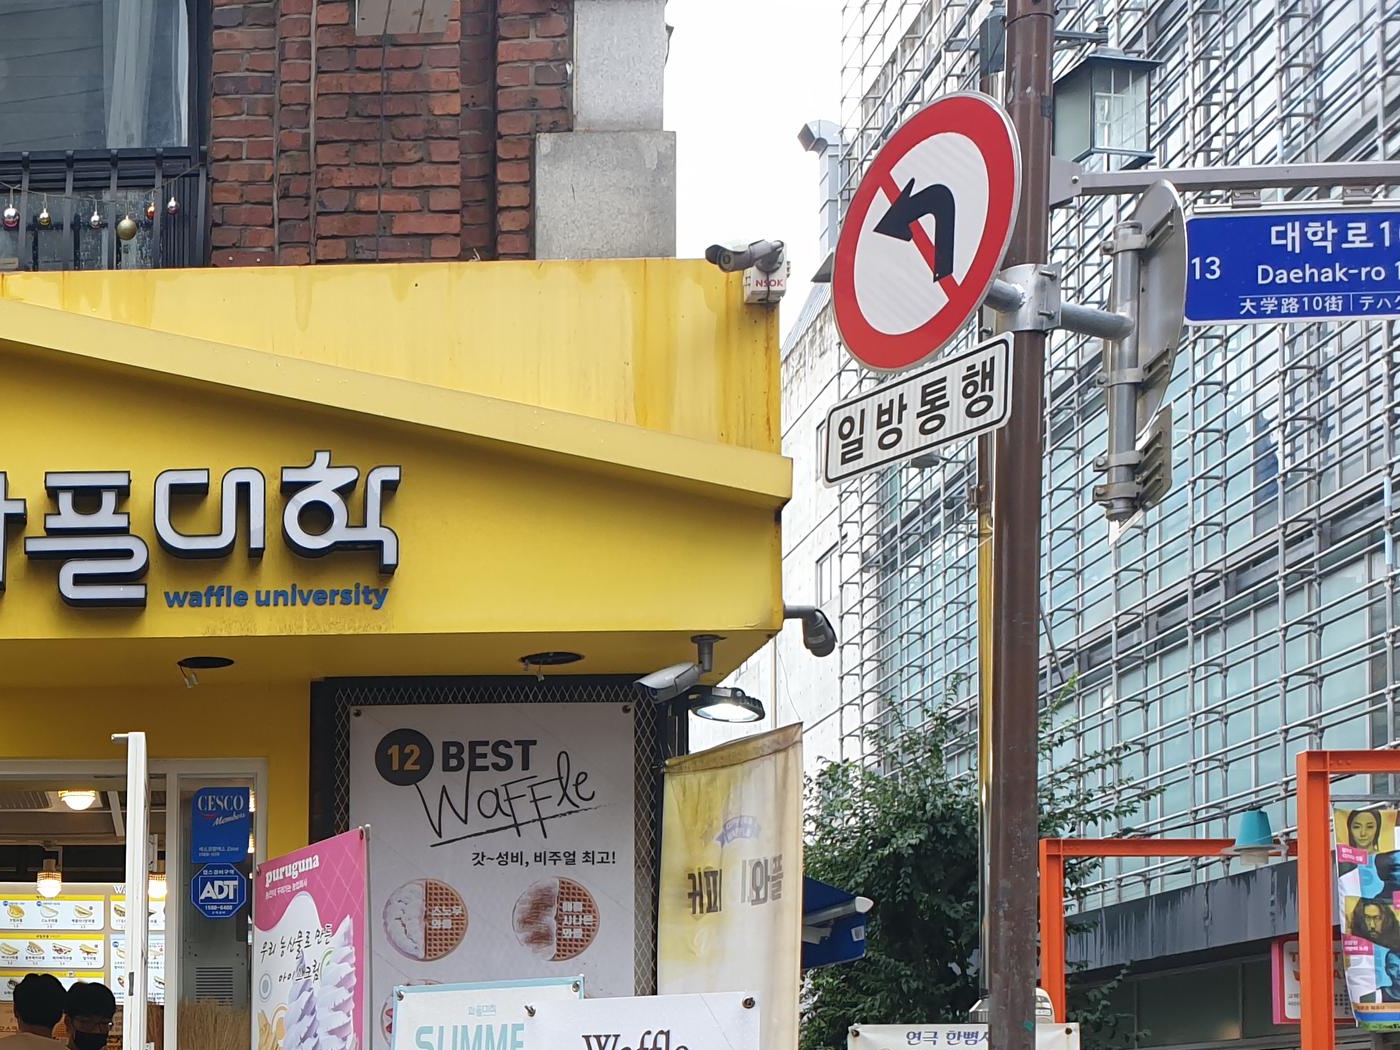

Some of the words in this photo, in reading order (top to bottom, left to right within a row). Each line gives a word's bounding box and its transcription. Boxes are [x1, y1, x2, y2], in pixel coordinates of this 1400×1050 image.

[1271, 220, 1400, 254] 대학로1
[1191, 257, 1221, 280] 13
[1257, 263, 1385, 285] Daehak-ro
[754, 277, 784, 289] NSOK
[1239, 296, 1343, 315] 大学路10街
[836, 354, 997, 460] 일방통행
[164, 585, 249, 608] waffle
[255, 583, 389, 610] university
[386, 746, 421, 771] 12
[441, 740, 537, 772] BEST
[198, 795, 244, 811] CESCO
[471, 849, 529, 867] 갓~성비,
[533, 850, 577, 867] 비주얼
[580, 850, 616, 866] 최고!
[265, 854, 320, 888] puruguna
[751, 854, 783, 905] 와플
[200, 880, 238, 900] ADT
[260, 941, 276, 963] 우리
[314, 926, 333, 944] 만든
[906, 1030, 938, 1047] 연극
